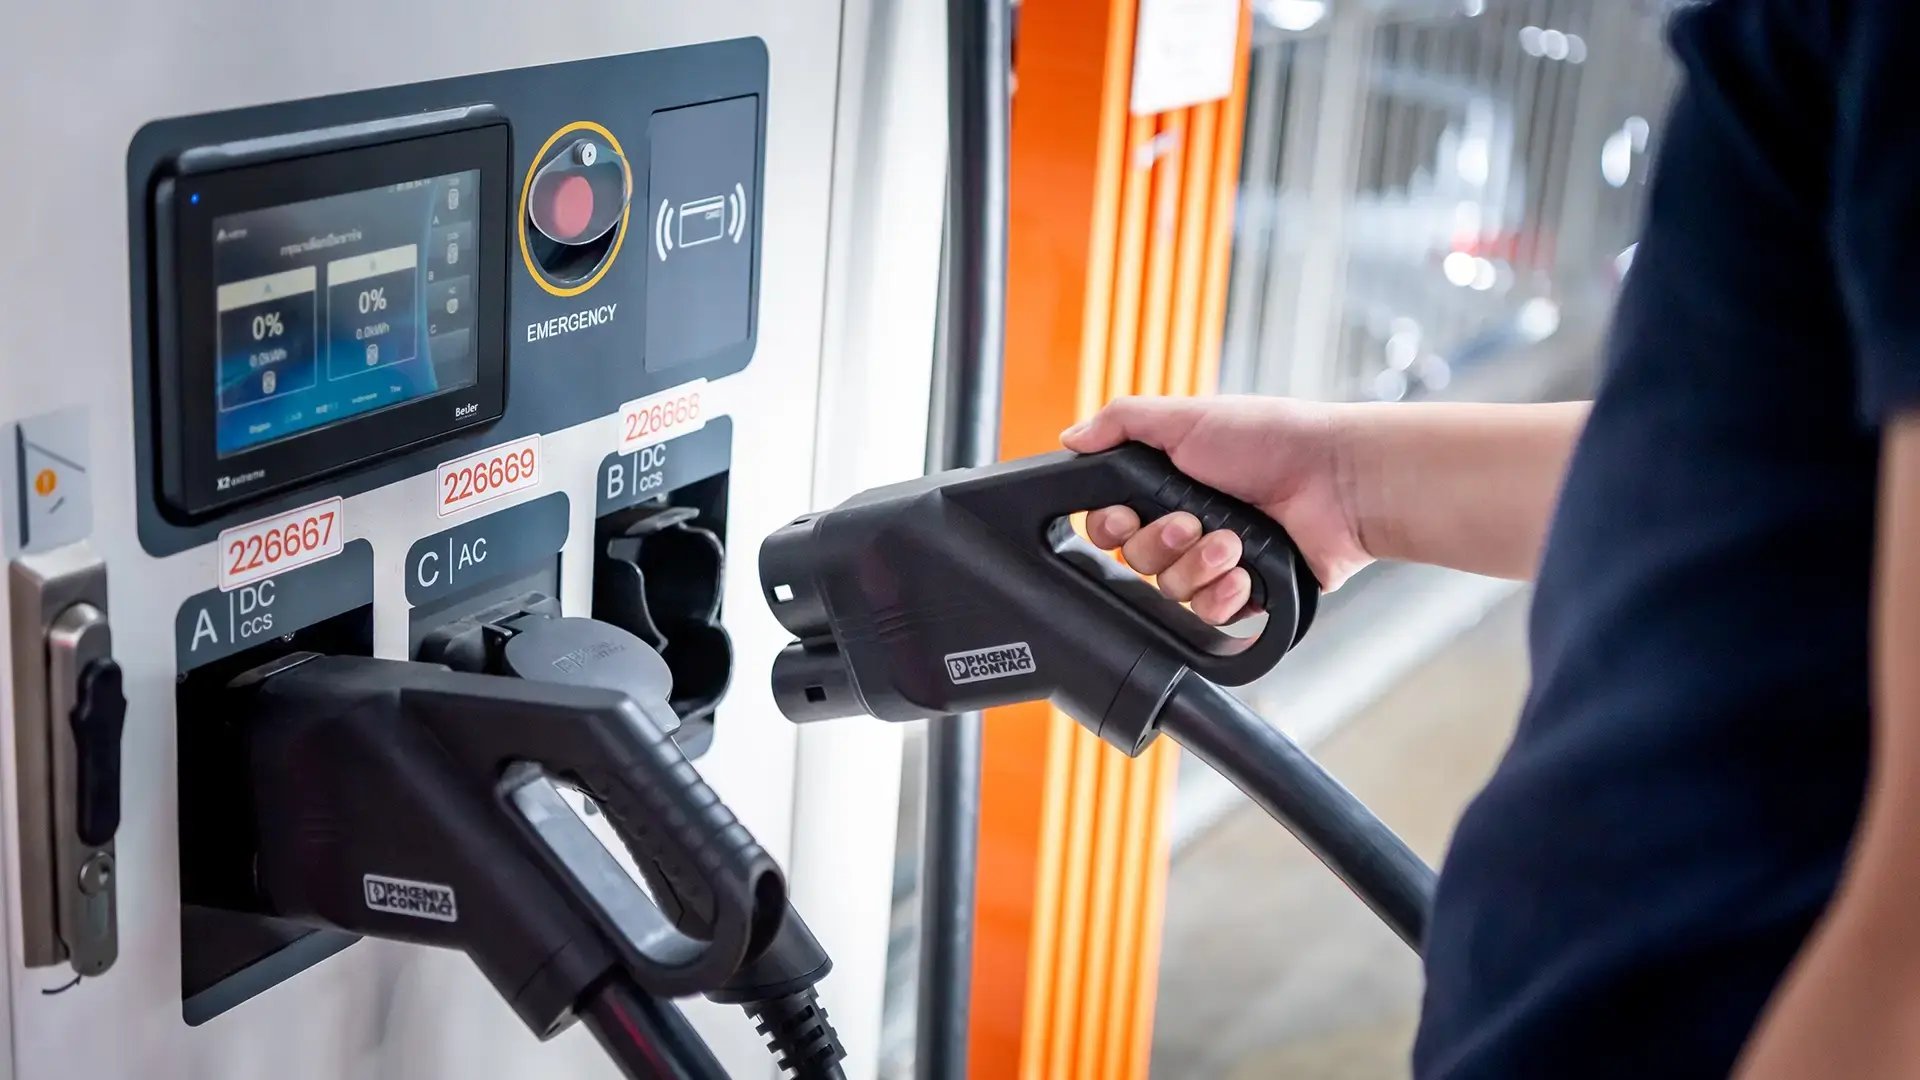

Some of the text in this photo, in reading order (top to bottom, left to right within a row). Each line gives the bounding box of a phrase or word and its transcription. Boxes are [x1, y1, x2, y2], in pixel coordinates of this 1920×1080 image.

[358, 287, 387, 314] 0%
[252, 311, 284, 341] 0%
[527, 303, 617, 343] EMERGENCY
[625, 392, 700, 442] 226668
[640, 443, 666, 472] DC
[216, 476, 231, 491] X2
[444, 448, 535, 505] 226669
[607, 463, 624, 499] B
[639, 471, 663, 492] CCS
[229, 511, 335, 576] 226667
[458, 537, 487, 570] AC
[417, 551, 439, 587] C
[239, 579, 275, 615] DC
[191, 608, 218, 652] A
[240, 613, 273, 638] CCS
[970, 658, 1031, 677] CONTACT
[388, 896, 452, 915] CONTACT
